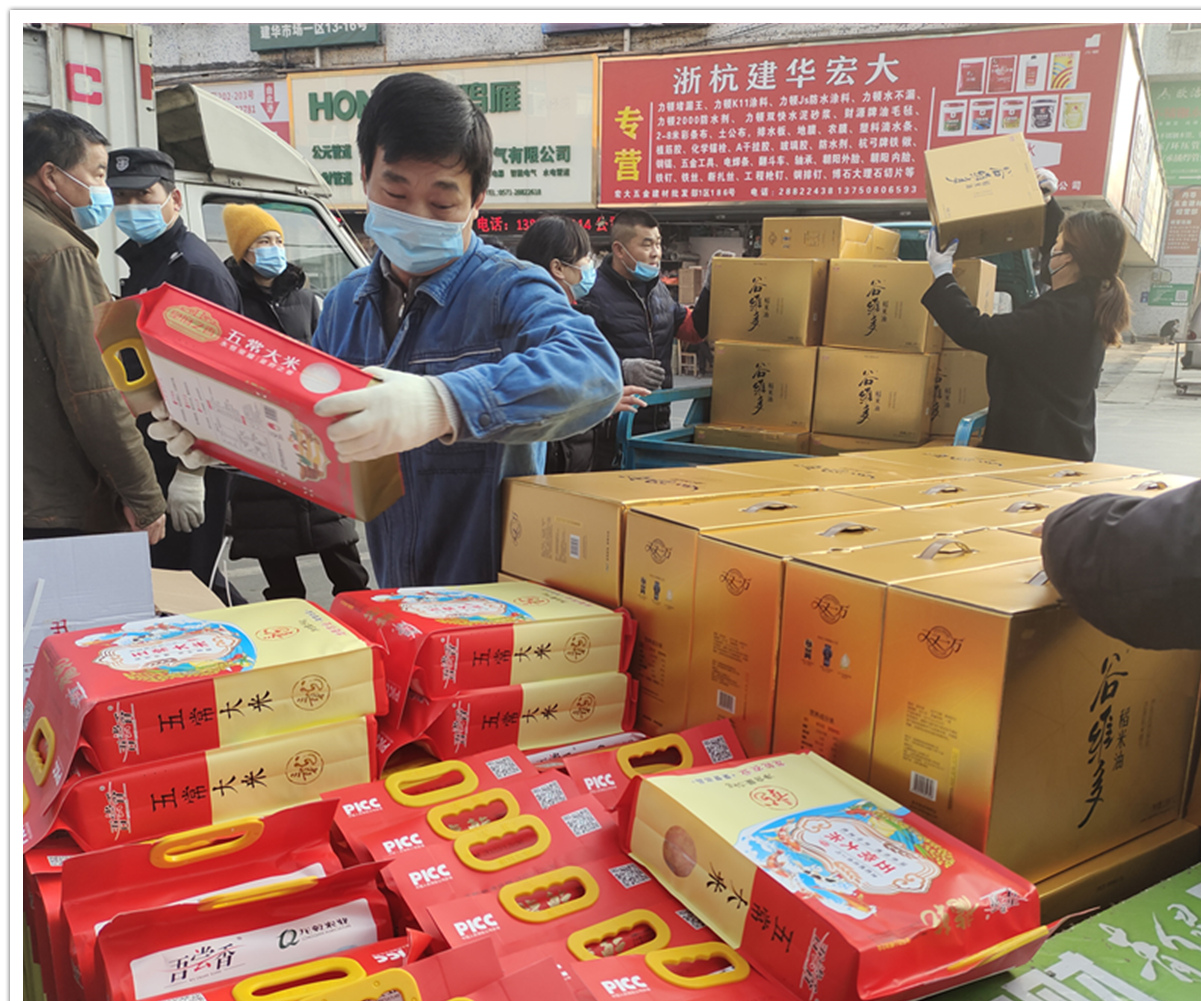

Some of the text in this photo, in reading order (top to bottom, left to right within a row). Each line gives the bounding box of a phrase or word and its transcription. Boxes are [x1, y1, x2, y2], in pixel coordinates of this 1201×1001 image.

[672, 52, 900, 95] 浙杭建华宏大
[614, 105, 644, 182] 专营
[837, 184, 918, 195] 13750806593
[223, 328, 301, 372] 五常大米
[471, 641, 552, 668] 五常大米
[158, 689, 273, 734] 五常大米
[481, 702, 559, 731] 五常大米
[149, 766, 267, 812] 五常大米
[583, 772, 616, 792] PICC
[342, 797, 382, 817] PICC
[382, 832, 424, 854] PICC
[408, 863, 451, 887] PICC
[453, 912, 498, 938] PICC
[600, 974, 649, 997] PICC
